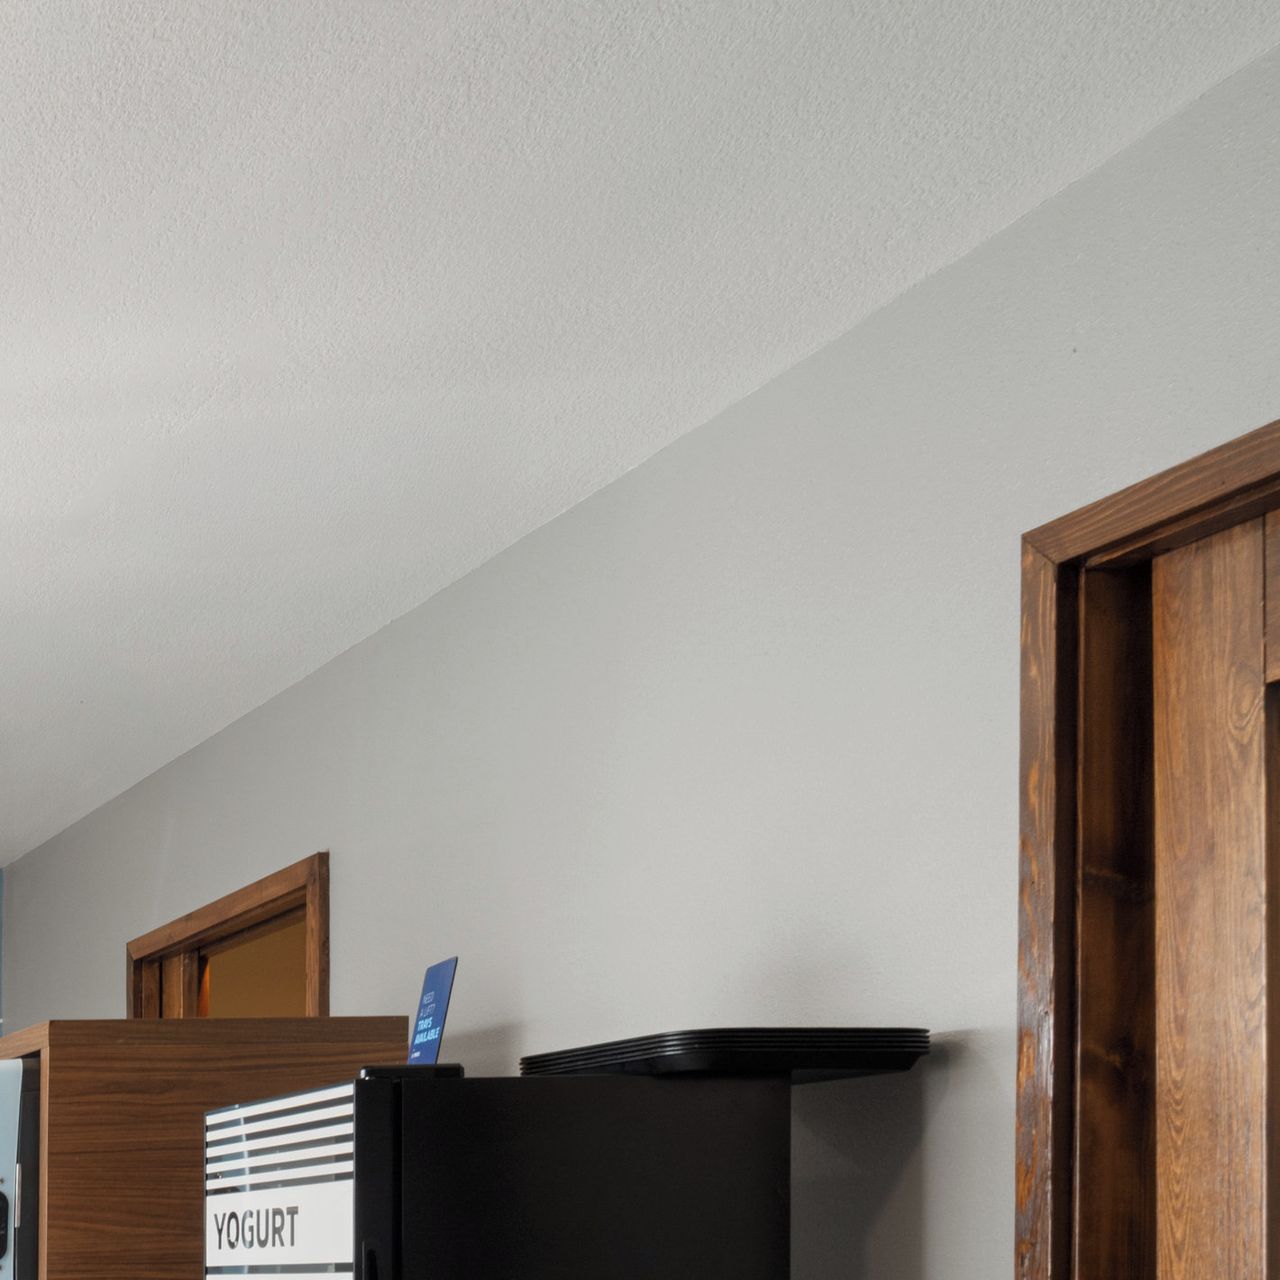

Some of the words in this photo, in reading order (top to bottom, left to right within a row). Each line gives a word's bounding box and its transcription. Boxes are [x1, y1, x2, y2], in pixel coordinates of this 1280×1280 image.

[417, 1016, 433, 1032] TRAYS
[413, 1026, 441, 1045] AVAILABLE
[213, 1204, 299, 1250] YOGURT
